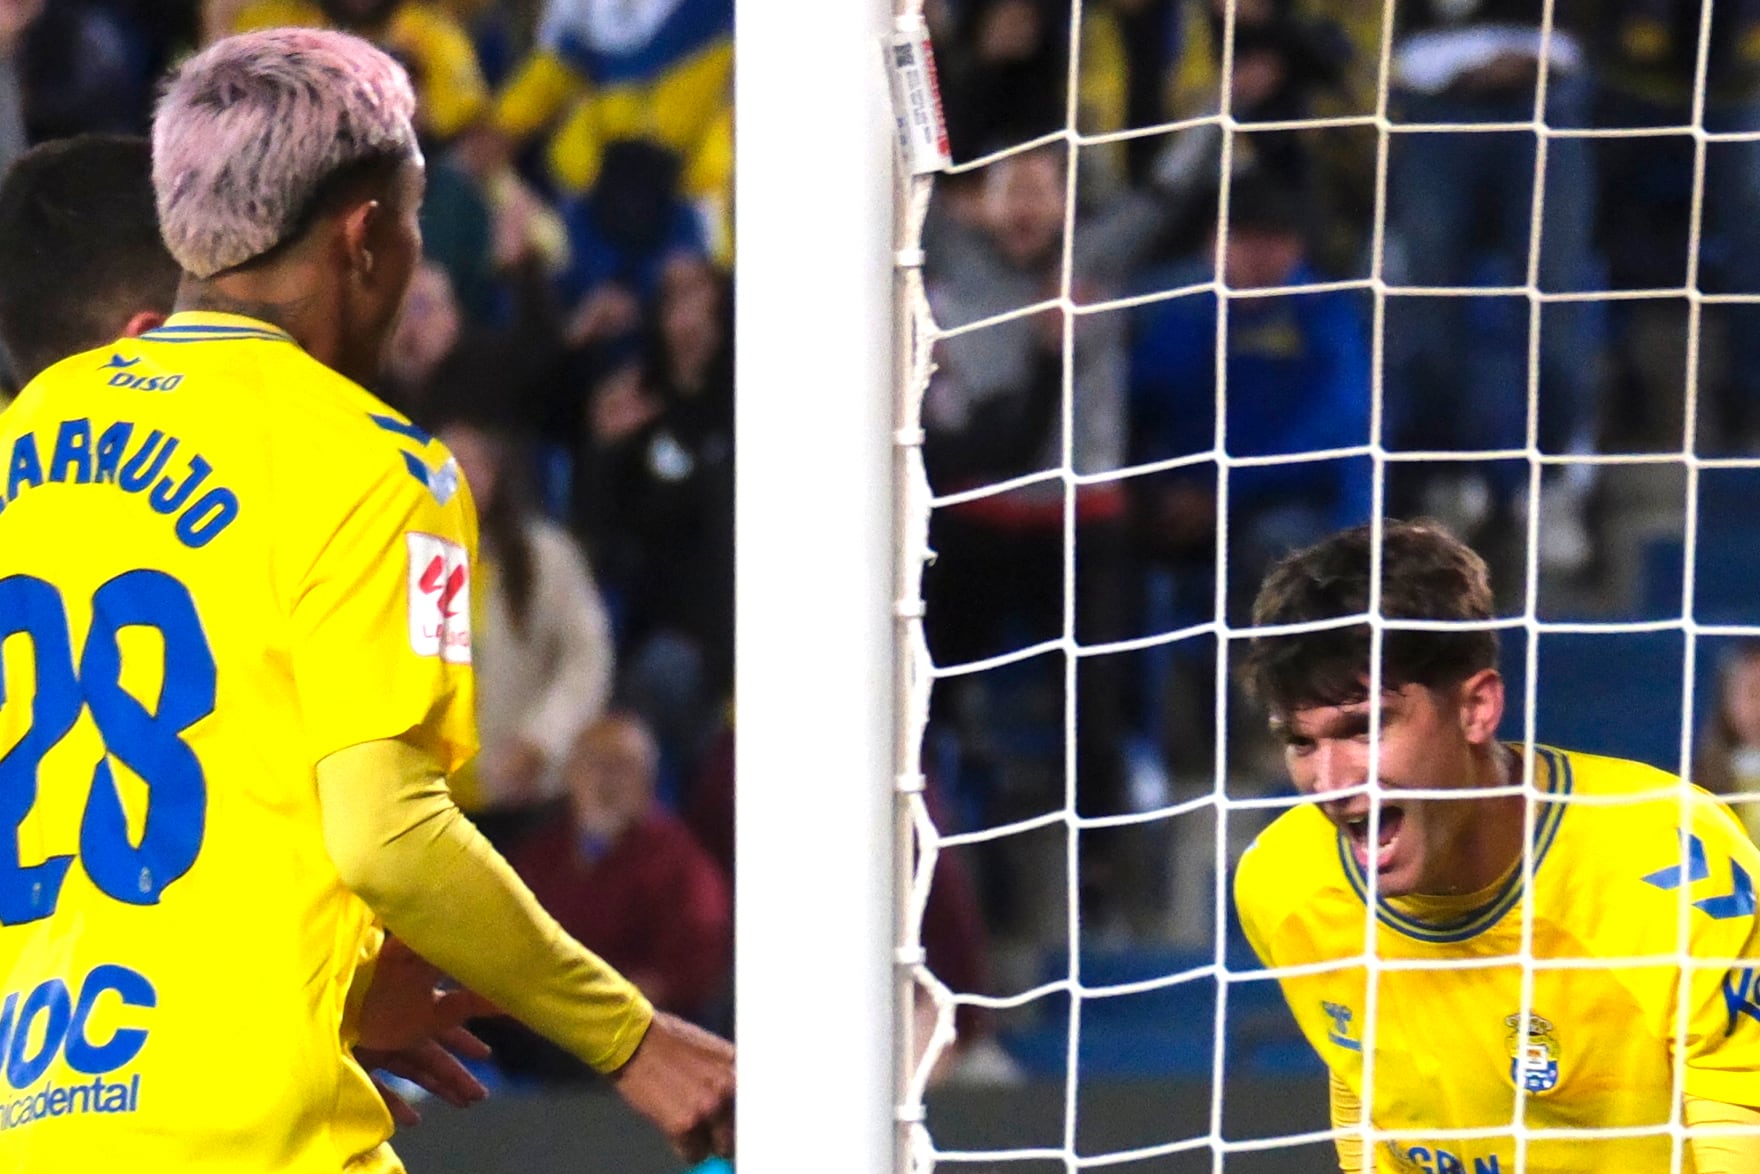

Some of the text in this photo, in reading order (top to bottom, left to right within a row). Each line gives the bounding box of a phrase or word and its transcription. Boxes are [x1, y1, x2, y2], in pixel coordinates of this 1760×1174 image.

[7, 417, 240, 549] ARAUJO
[0, 568, 218, 927] 28
[0, 963, 157, 1090] OC
[0, 1073, 141, 1131] icadental
